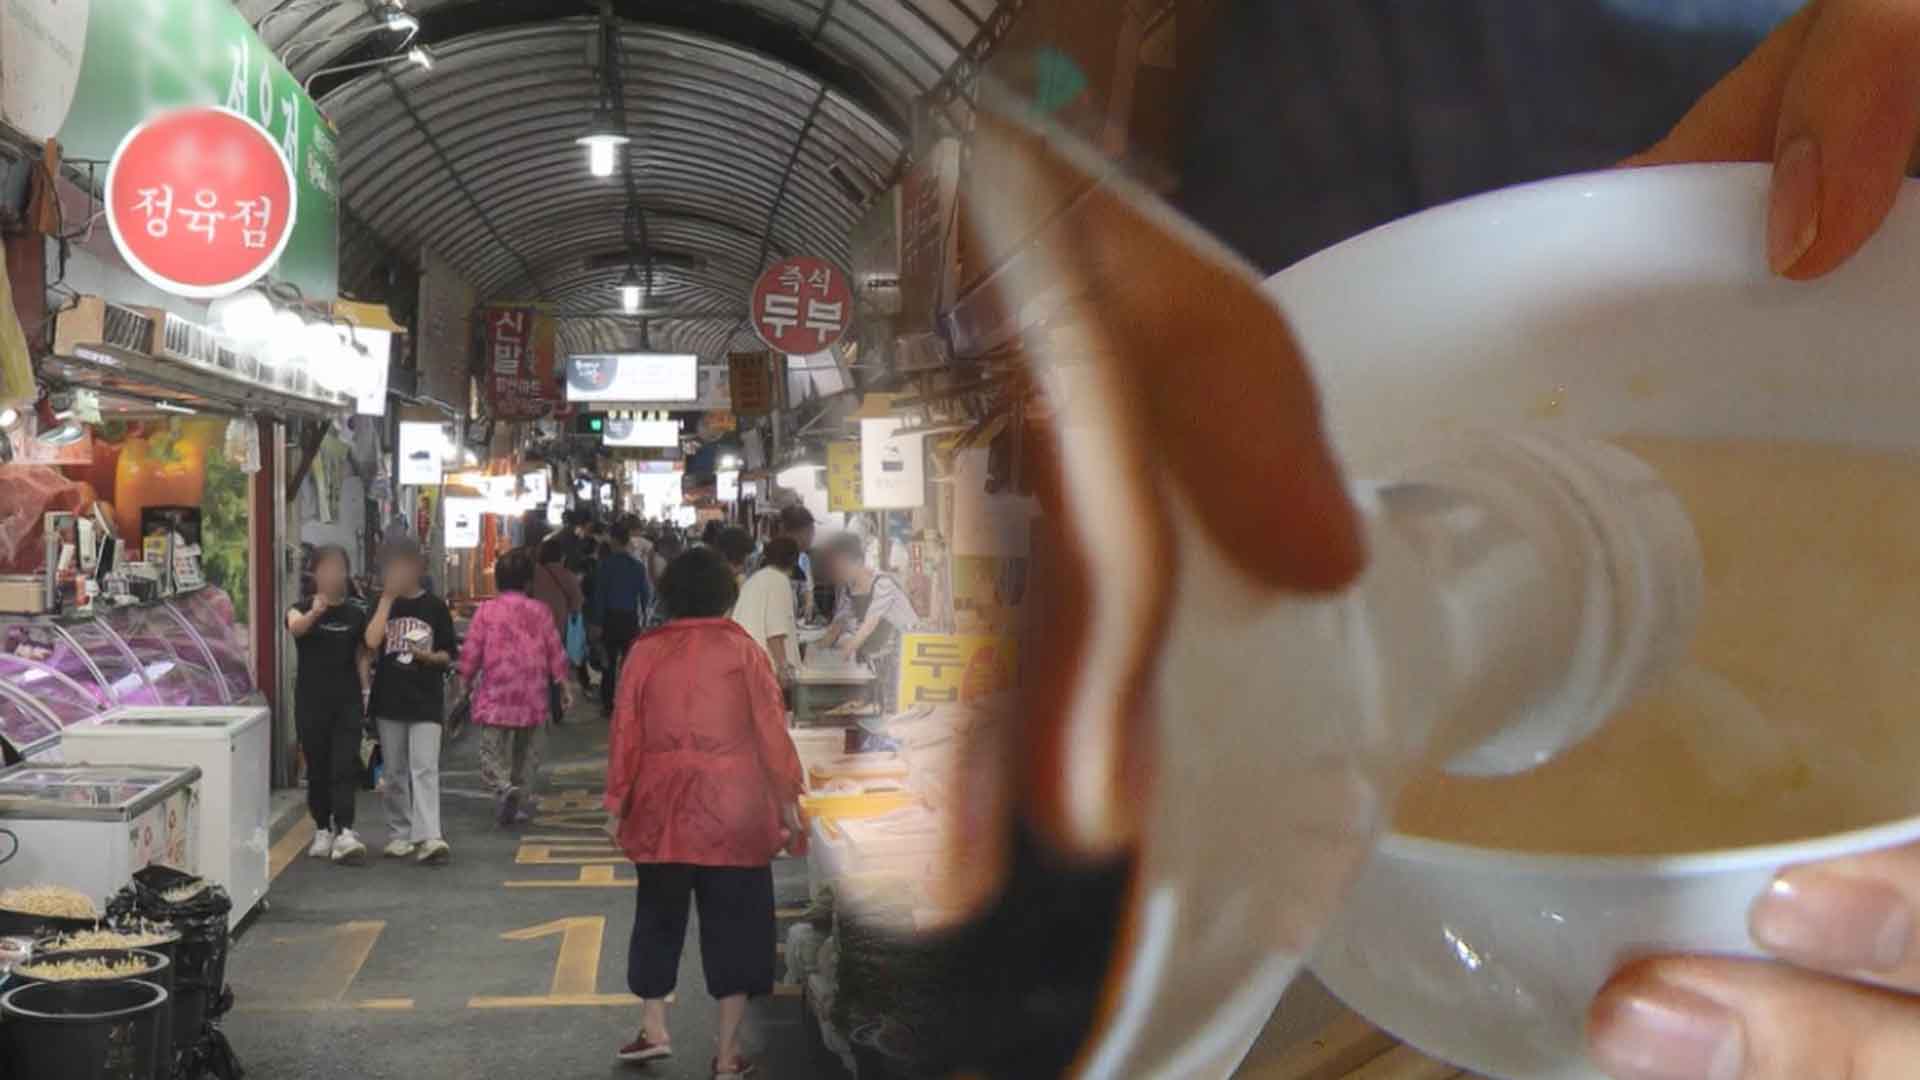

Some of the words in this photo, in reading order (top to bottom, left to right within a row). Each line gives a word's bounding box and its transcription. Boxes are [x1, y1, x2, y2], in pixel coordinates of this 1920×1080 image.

[129, 184, 271, 248] 정육점
[778, 264, 831, 297] 즉석
[495, 311, 523, 375] 신발
[762, 293, 843, 343] 두부
